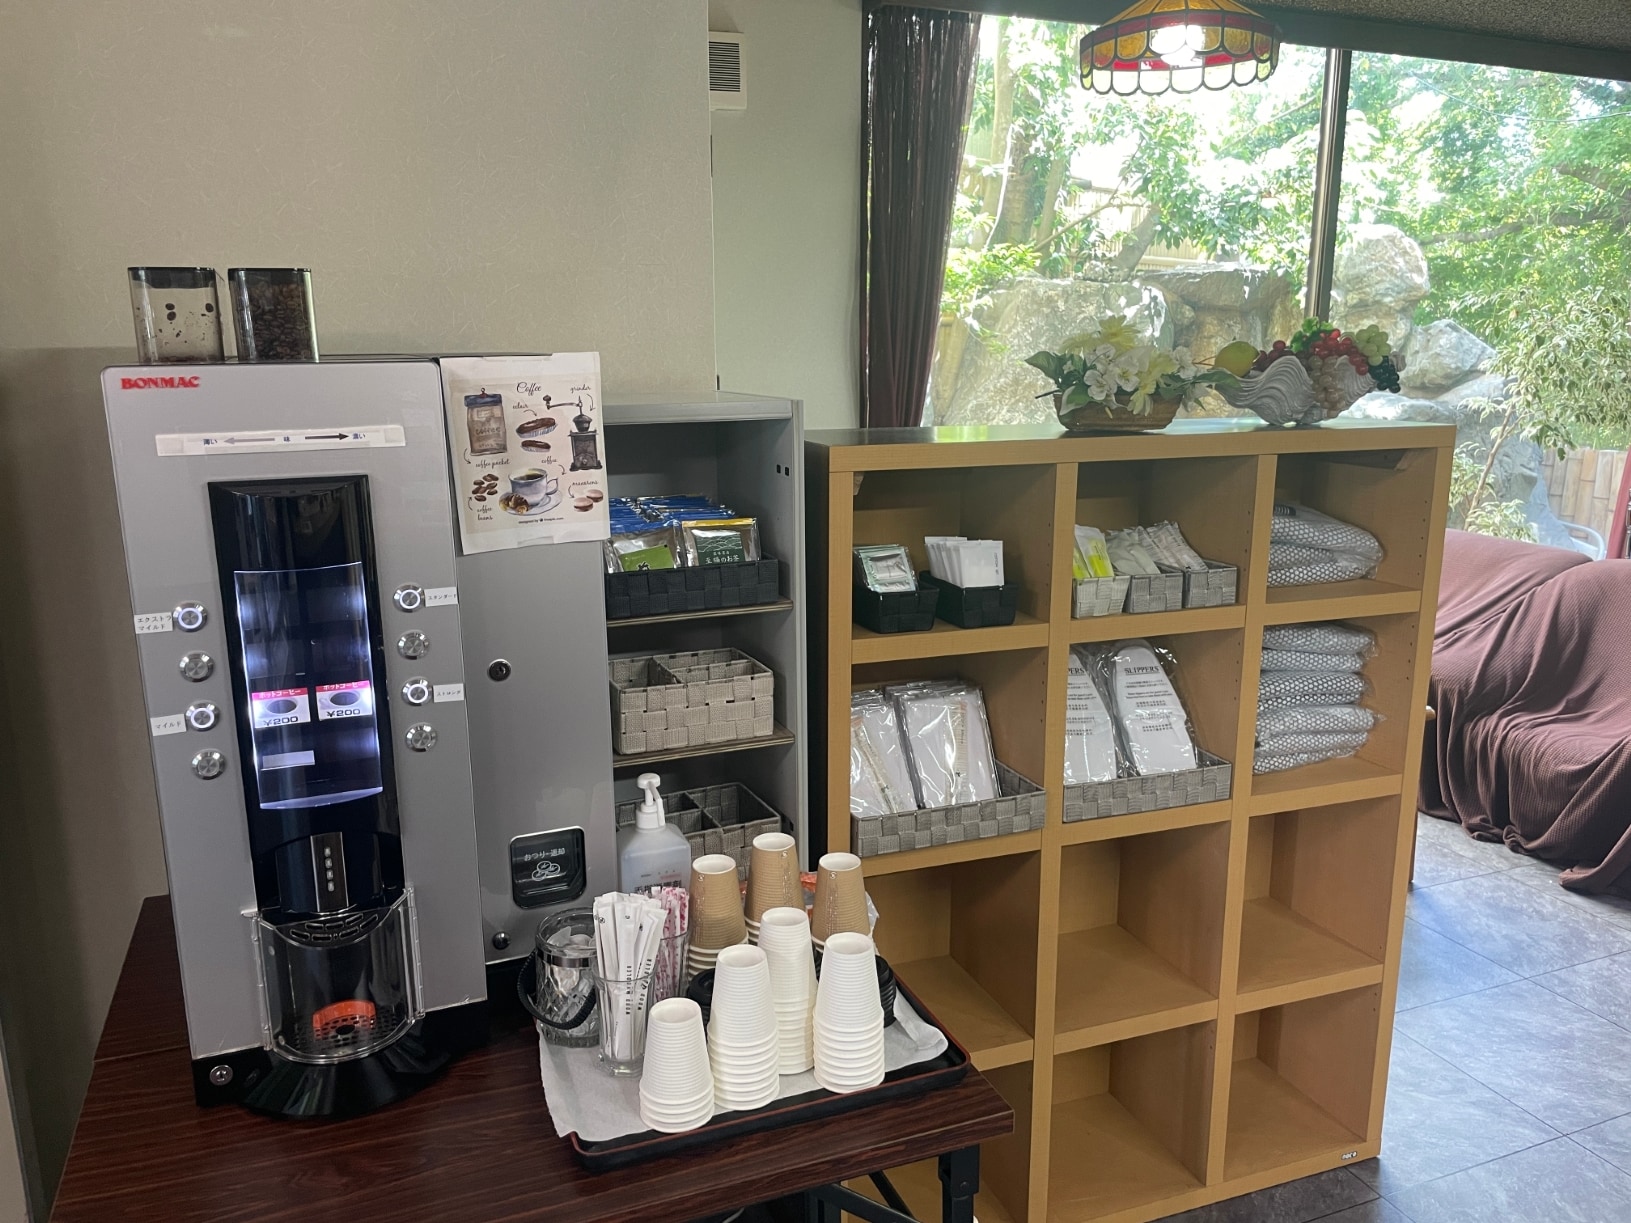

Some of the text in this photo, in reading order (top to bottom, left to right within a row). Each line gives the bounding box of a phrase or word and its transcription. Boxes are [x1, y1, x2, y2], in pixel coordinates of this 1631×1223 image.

[121, 376, 200, 389] BONMAC
[516, 381, 542, 396] Coffee
[137, 615, 172, 623] エクストラ
[1124, 666, 1160, 675] SLIPPERS
[323, 681, 364, 690] ホットコーヒー
[259, 689, 301, 699] ホットコーヒー
[326, 708, 361, 718] ¥200
[156, 720, 182, 729] マイルド
[263, 715, 299, 727] ¥200
[637, 993, 645, 1011] WOOD
